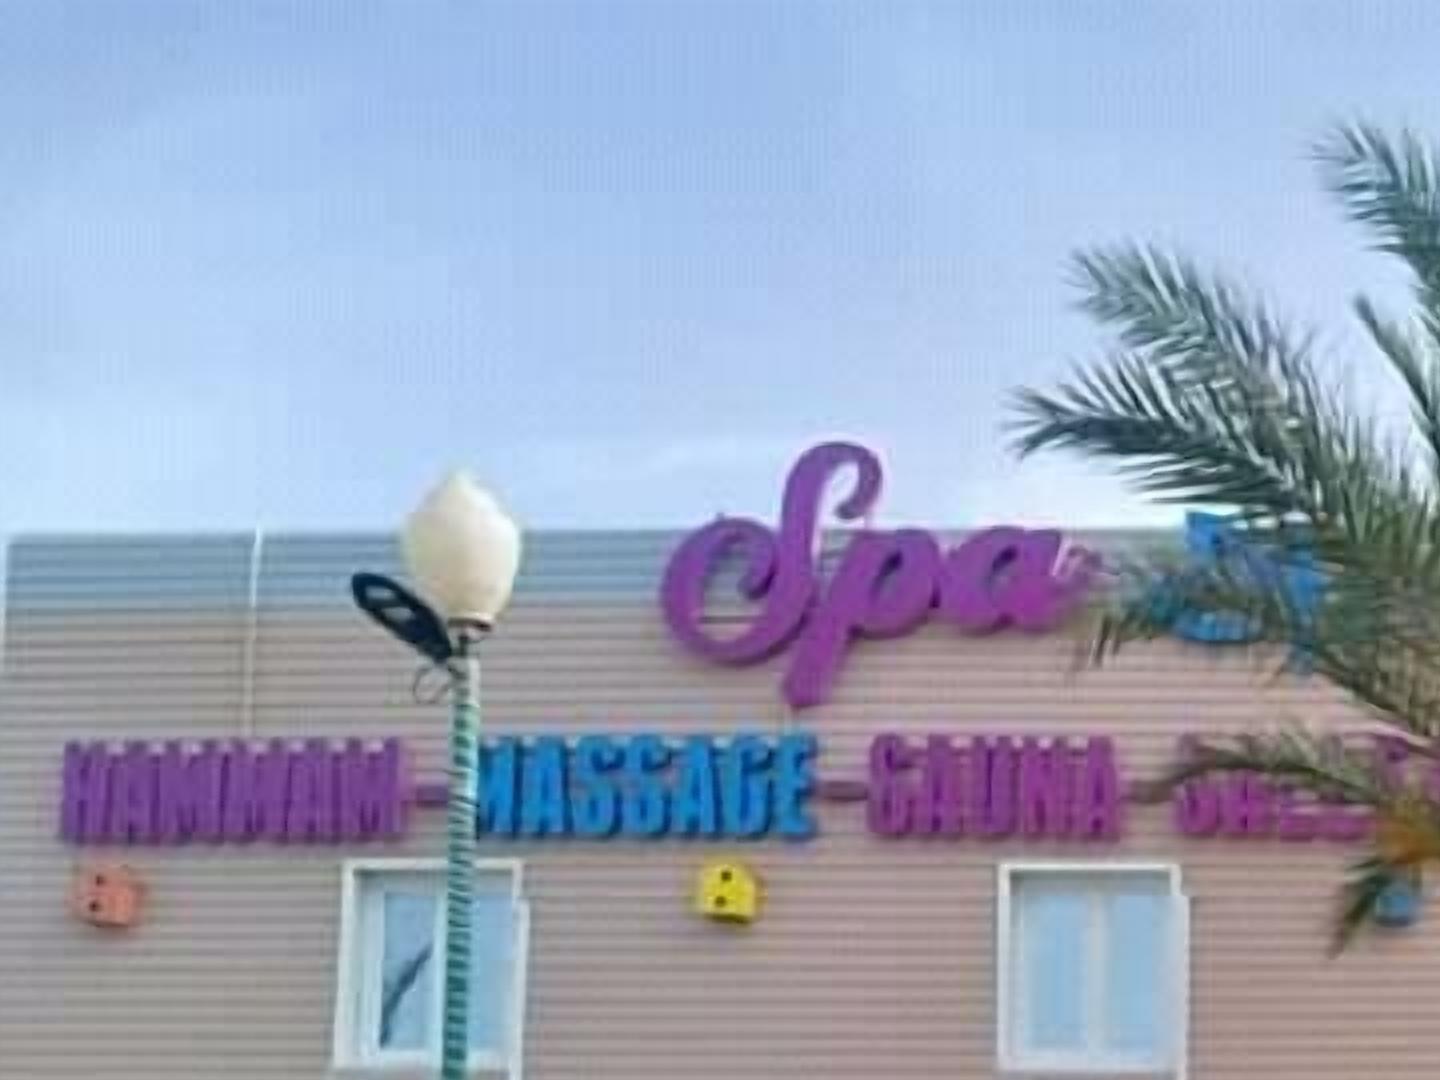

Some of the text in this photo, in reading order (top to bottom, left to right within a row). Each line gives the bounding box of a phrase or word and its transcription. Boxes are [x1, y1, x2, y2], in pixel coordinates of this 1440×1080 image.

[660, 441, 1098, 708] Spa
[63, 738, 406, 844] HAMMAM
[868, 734, 1118, 842] SAUNA
